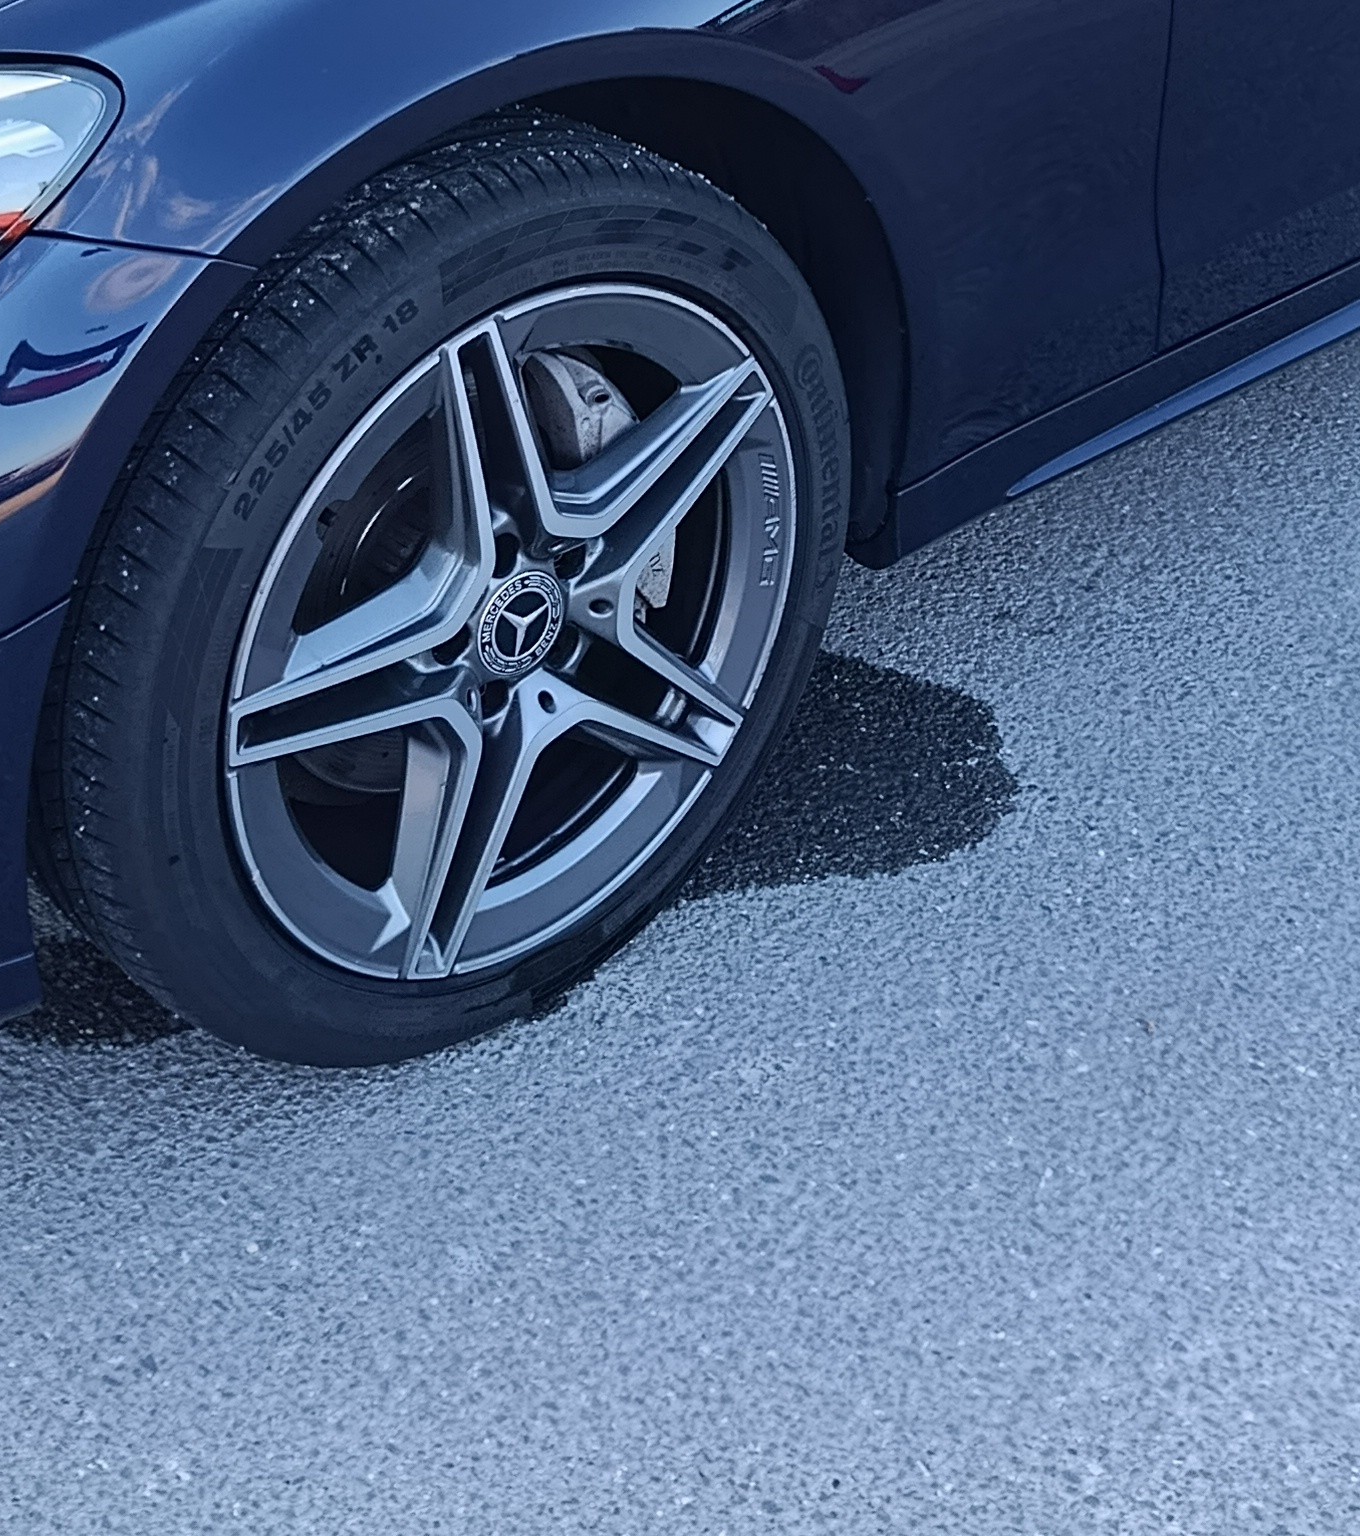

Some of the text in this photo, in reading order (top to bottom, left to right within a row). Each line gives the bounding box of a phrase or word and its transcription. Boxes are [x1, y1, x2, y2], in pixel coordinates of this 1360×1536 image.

[232, 297, 420, 522] 225/45 ZR 18
[793, 343, 843, 560] Continental
[481, 580, 523, 644] MERCEDES
[534, 622, 559, 657] BENZ
